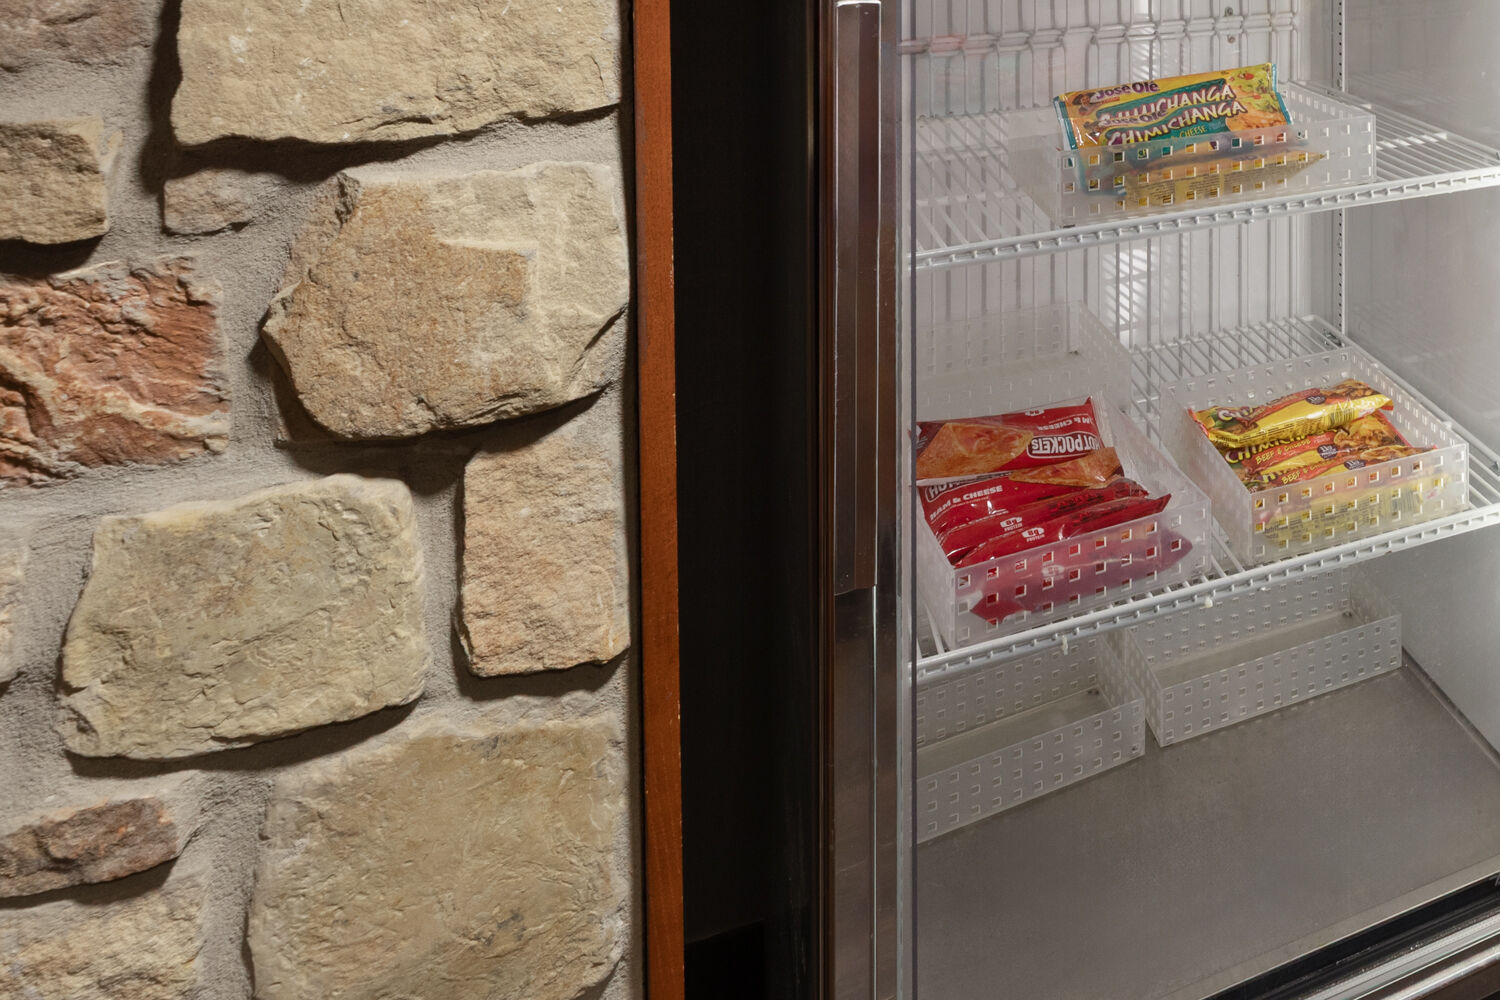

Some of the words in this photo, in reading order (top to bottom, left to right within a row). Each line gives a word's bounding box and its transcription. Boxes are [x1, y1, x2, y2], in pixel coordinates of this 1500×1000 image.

[1031, 433, 1084, 454] POCKETS
[930, 500, 951, 521] HAM
[952, 495, 962, 504] &
[963, 485, 1003, 500] CHEESE
